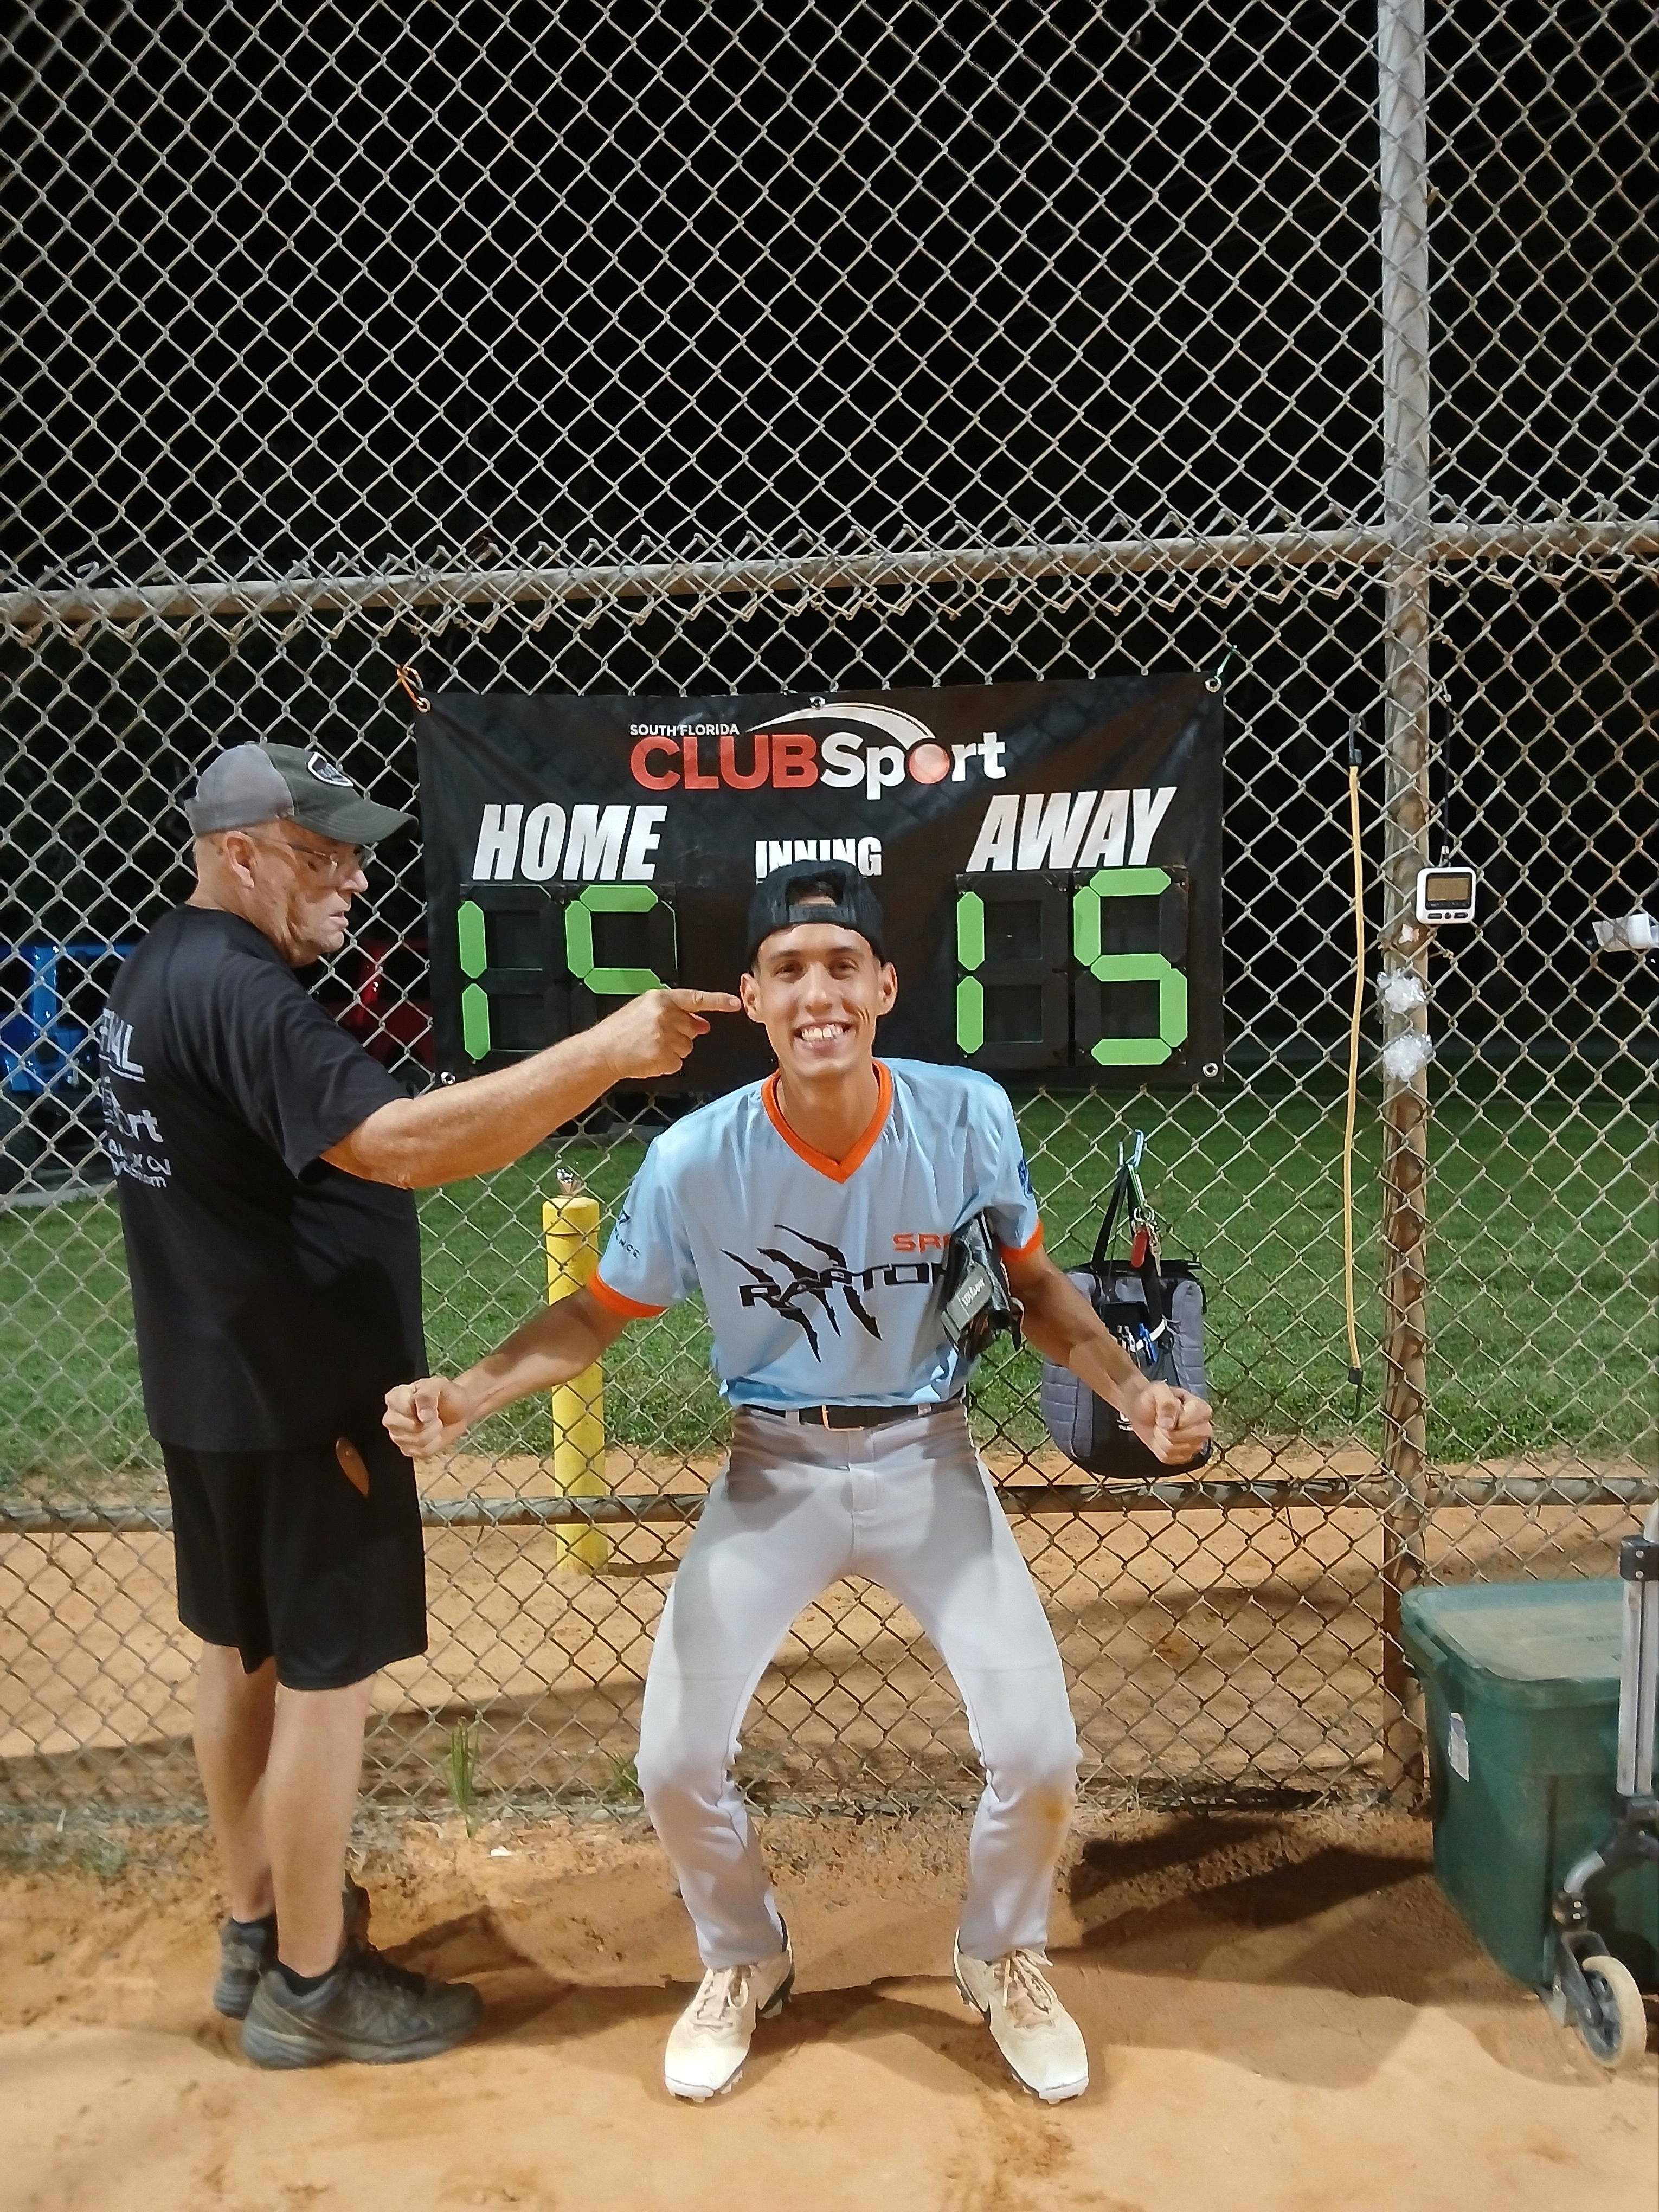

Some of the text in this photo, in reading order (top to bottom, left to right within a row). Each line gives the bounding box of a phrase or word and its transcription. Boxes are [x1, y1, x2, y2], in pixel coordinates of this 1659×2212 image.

[629, 723, 740, 736] SOUTH FLORIDA
[472, 802, 668, 881] HOME
[966, 786, 1178, 872] AWAY
[956, 867, 1188, 1065] 15
[961, 1277, 986, 1306] Wilson
